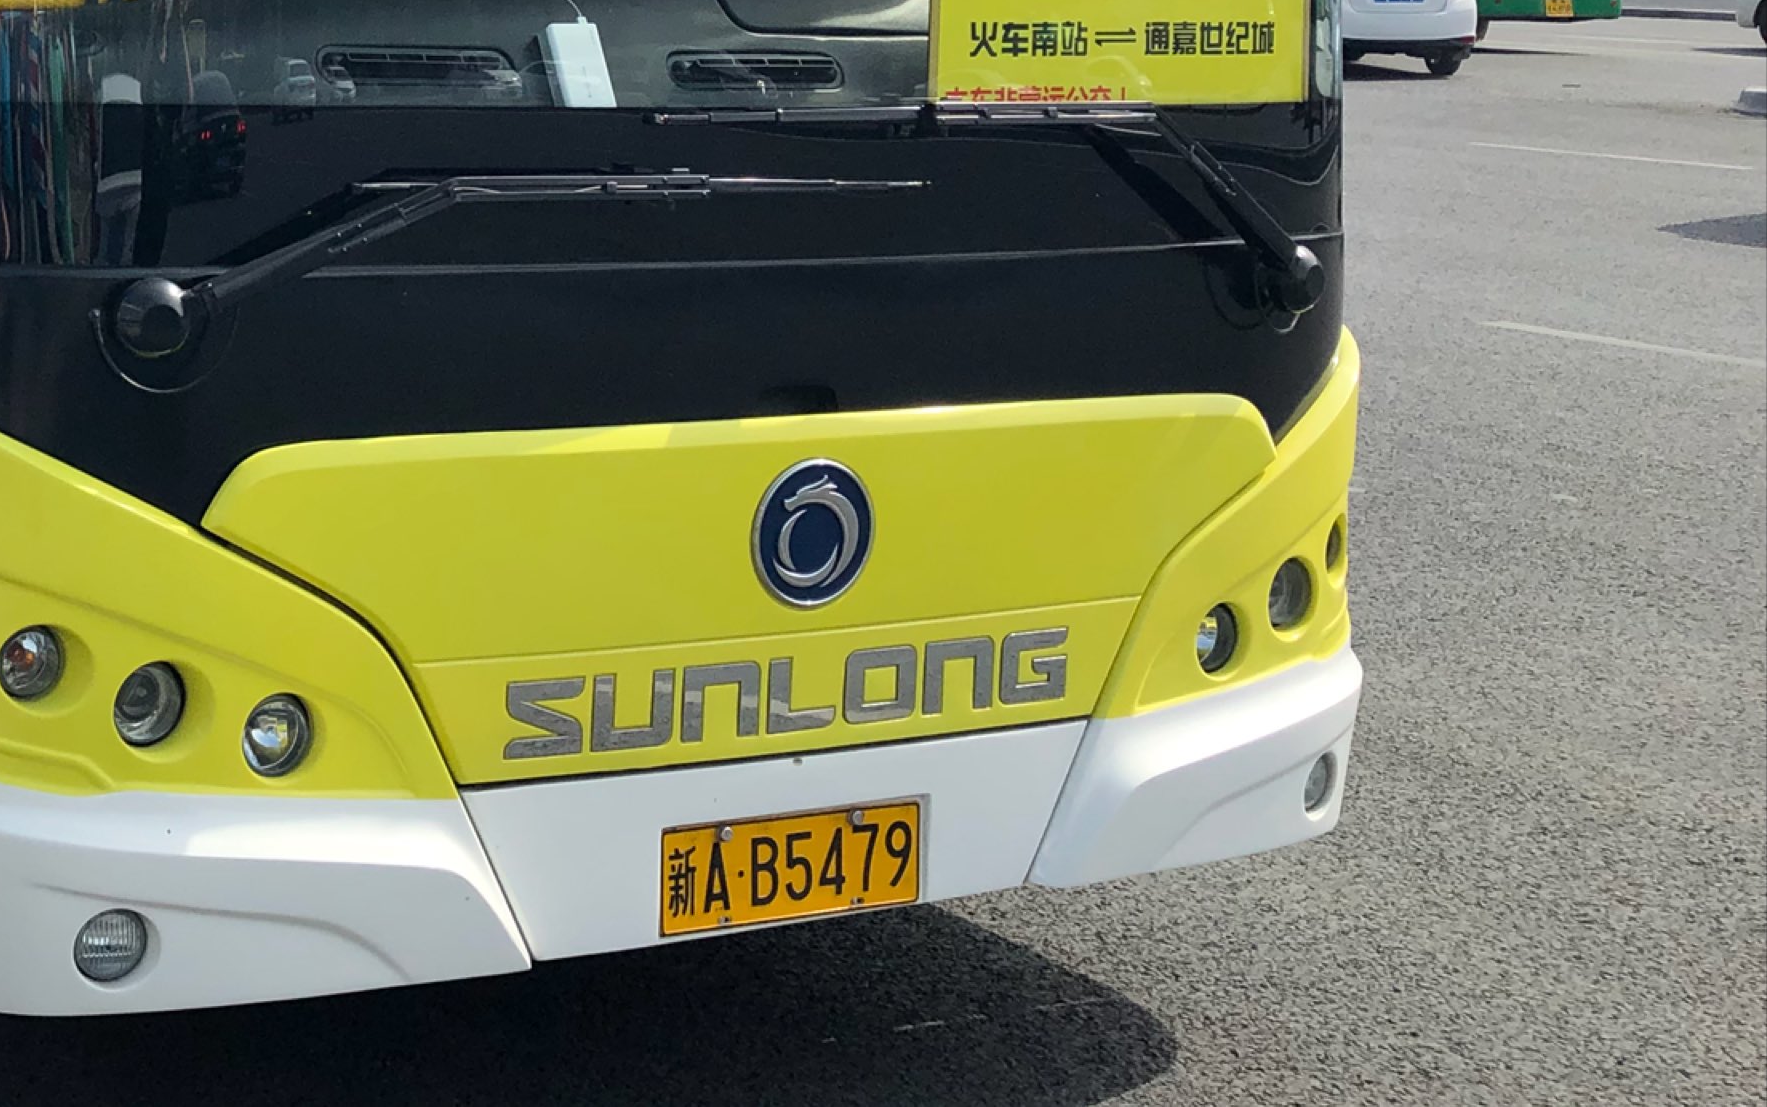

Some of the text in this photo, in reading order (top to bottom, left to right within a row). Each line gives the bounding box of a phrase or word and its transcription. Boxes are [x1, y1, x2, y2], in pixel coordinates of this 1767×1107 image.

[969, 20, 1276, 58] 火车南站 通嘉世纪城
[502, 625, 1070, 760] SUNLONG
[667, 818, 914, 918] 新A·B5479
